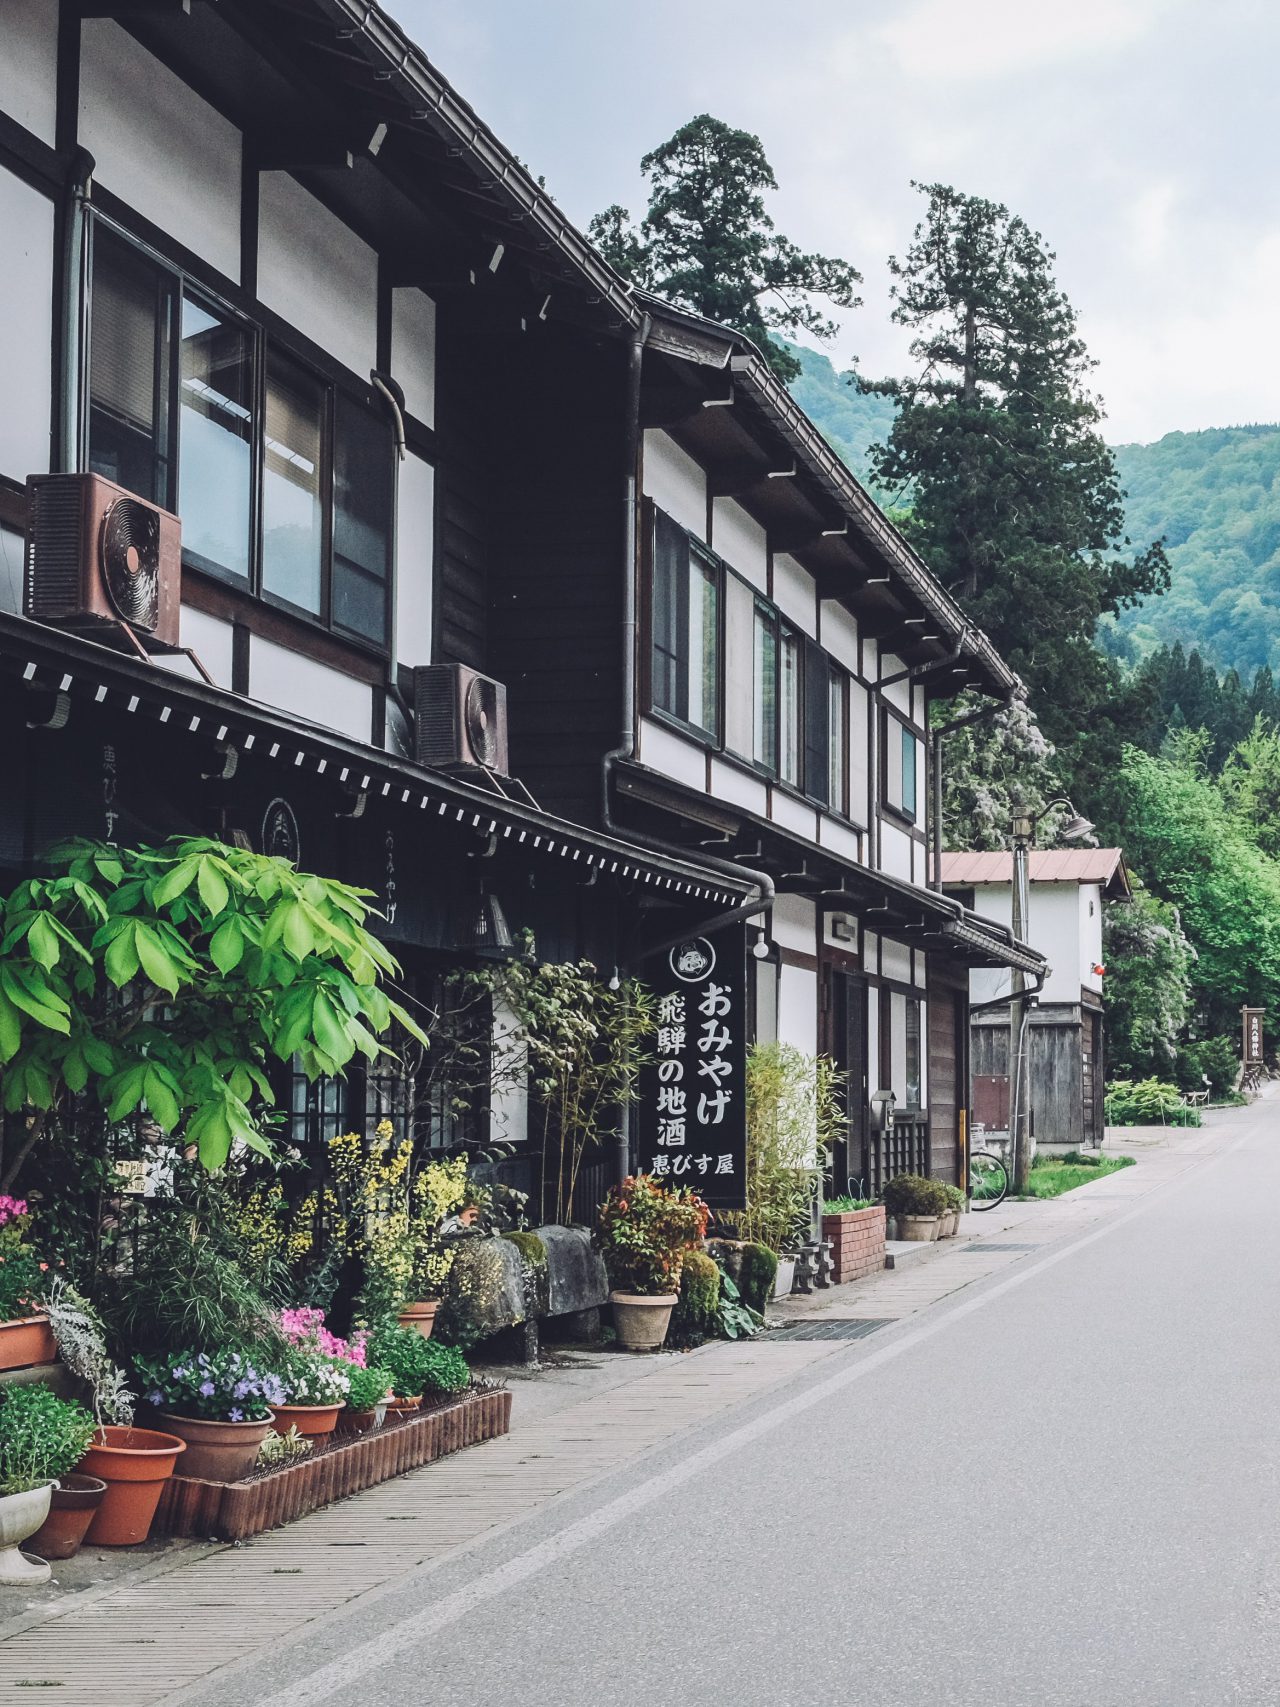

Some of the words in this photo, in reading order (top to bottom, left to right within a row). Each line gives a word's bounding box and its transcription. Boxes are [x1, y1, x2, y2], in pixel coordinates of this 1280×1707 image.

[656, 994, 687, 1147] 飛騨の地酒
[697, 982, 732, 1124] おみやげ
[651, 1153, 735, 1176] 恵びす屋
